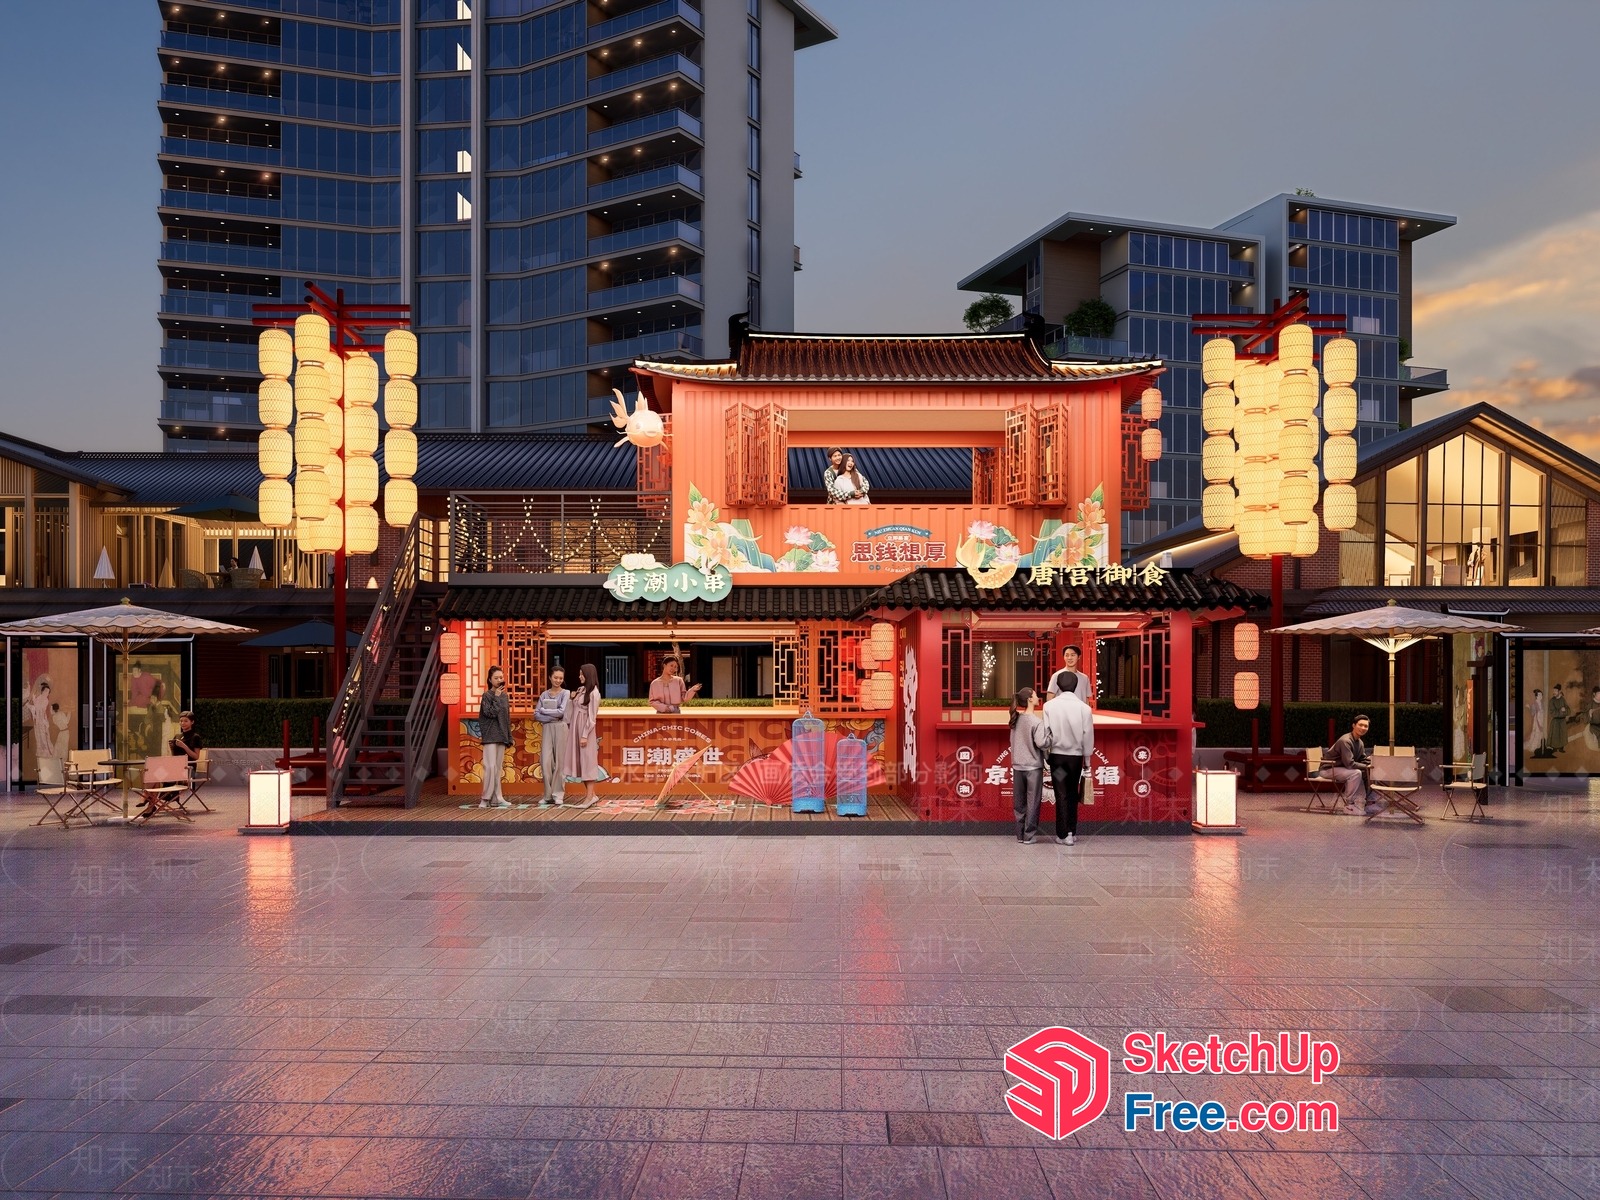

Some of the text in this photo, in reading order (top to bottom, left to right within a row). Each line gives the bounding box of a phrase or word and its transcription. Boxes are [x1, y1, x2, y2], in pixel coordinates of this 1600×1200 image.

[851, 541, 946, 563] 思钱想厚
[616, 571, 726, 593] 唐潮小串
[1025, 561, 1170, 587] 唐宫御食
[633, 725, 712, 744] CHINA-CHIC COMES
